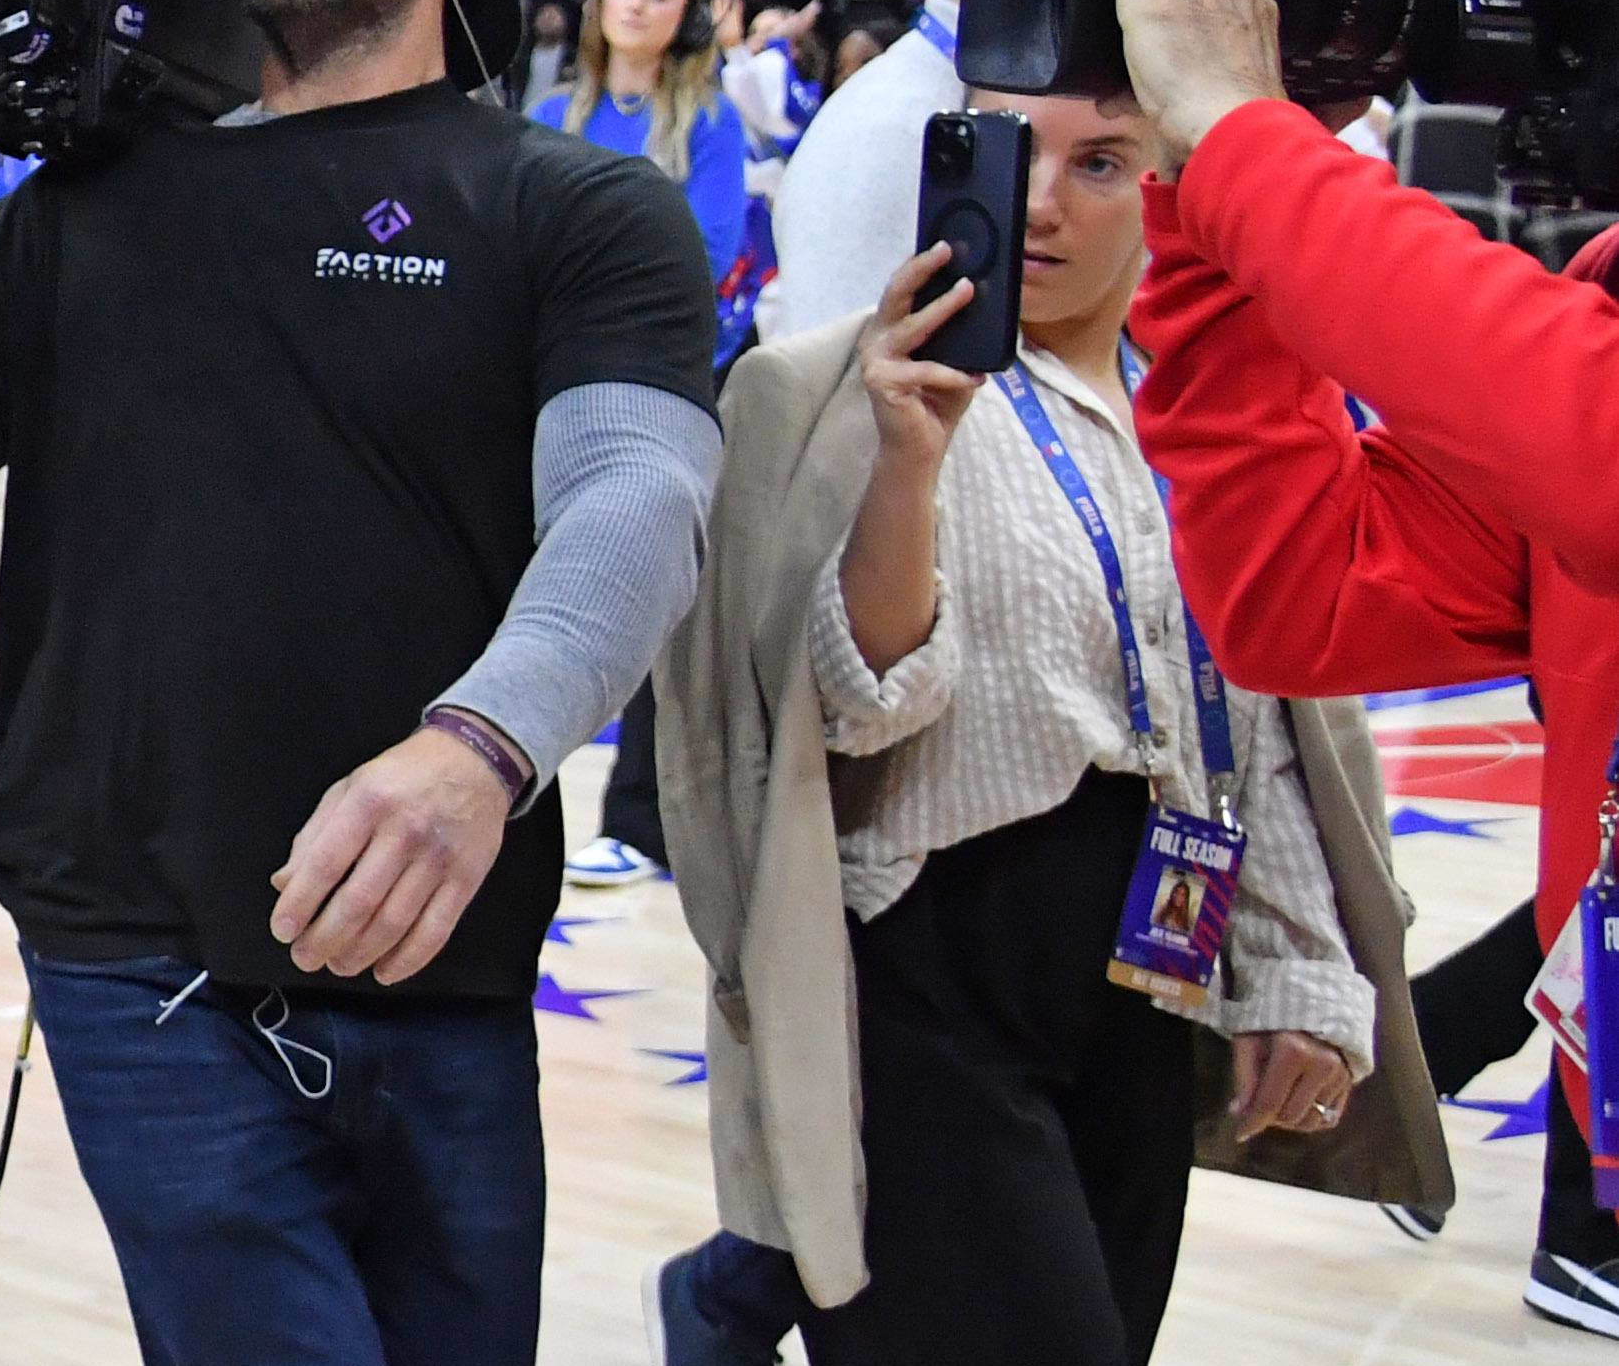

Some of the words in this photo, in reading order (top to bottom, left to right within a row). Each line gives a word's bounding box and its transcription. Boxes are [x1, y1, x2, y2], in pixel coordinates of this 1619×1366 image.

[316, 248, 446, 278] FACTION
[1150, 826, 1182, 857] FULL
[1182, 836, 1234, 871] SEASON
